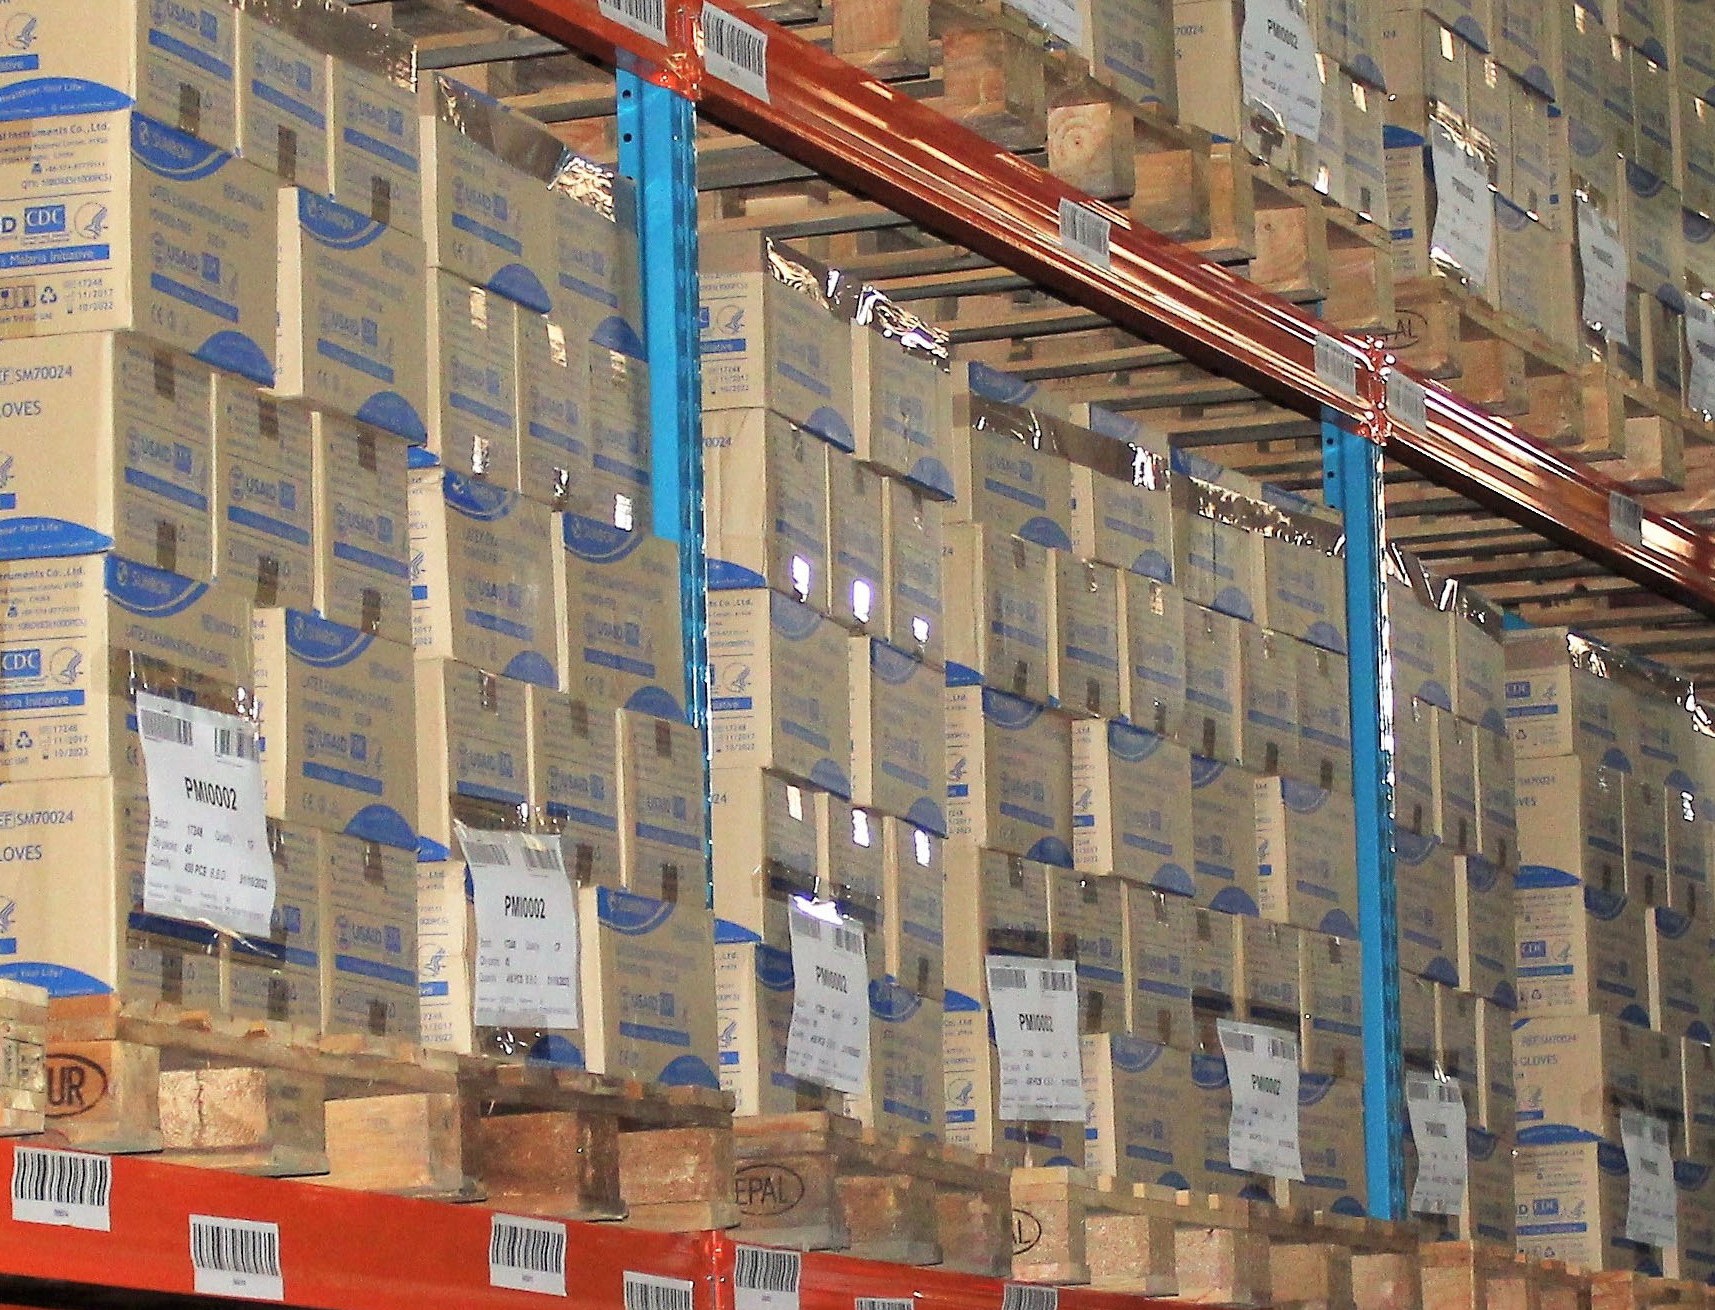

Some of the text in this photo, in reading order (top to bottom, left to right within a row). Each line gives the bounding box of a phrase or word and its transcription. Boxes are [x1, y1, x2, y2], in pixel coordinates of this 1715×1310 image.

[25, 208, 63, 228] CDC
[16, 365, 73, 382] SM70024
[1, 652, 39, 671] CDC
[184, 776, 239, 811] PMI0002
[16, 810, 74, 826] SM70024
[504, 895, 546, 920] PMI0002
[48, 1072, 85, 1104] UR
